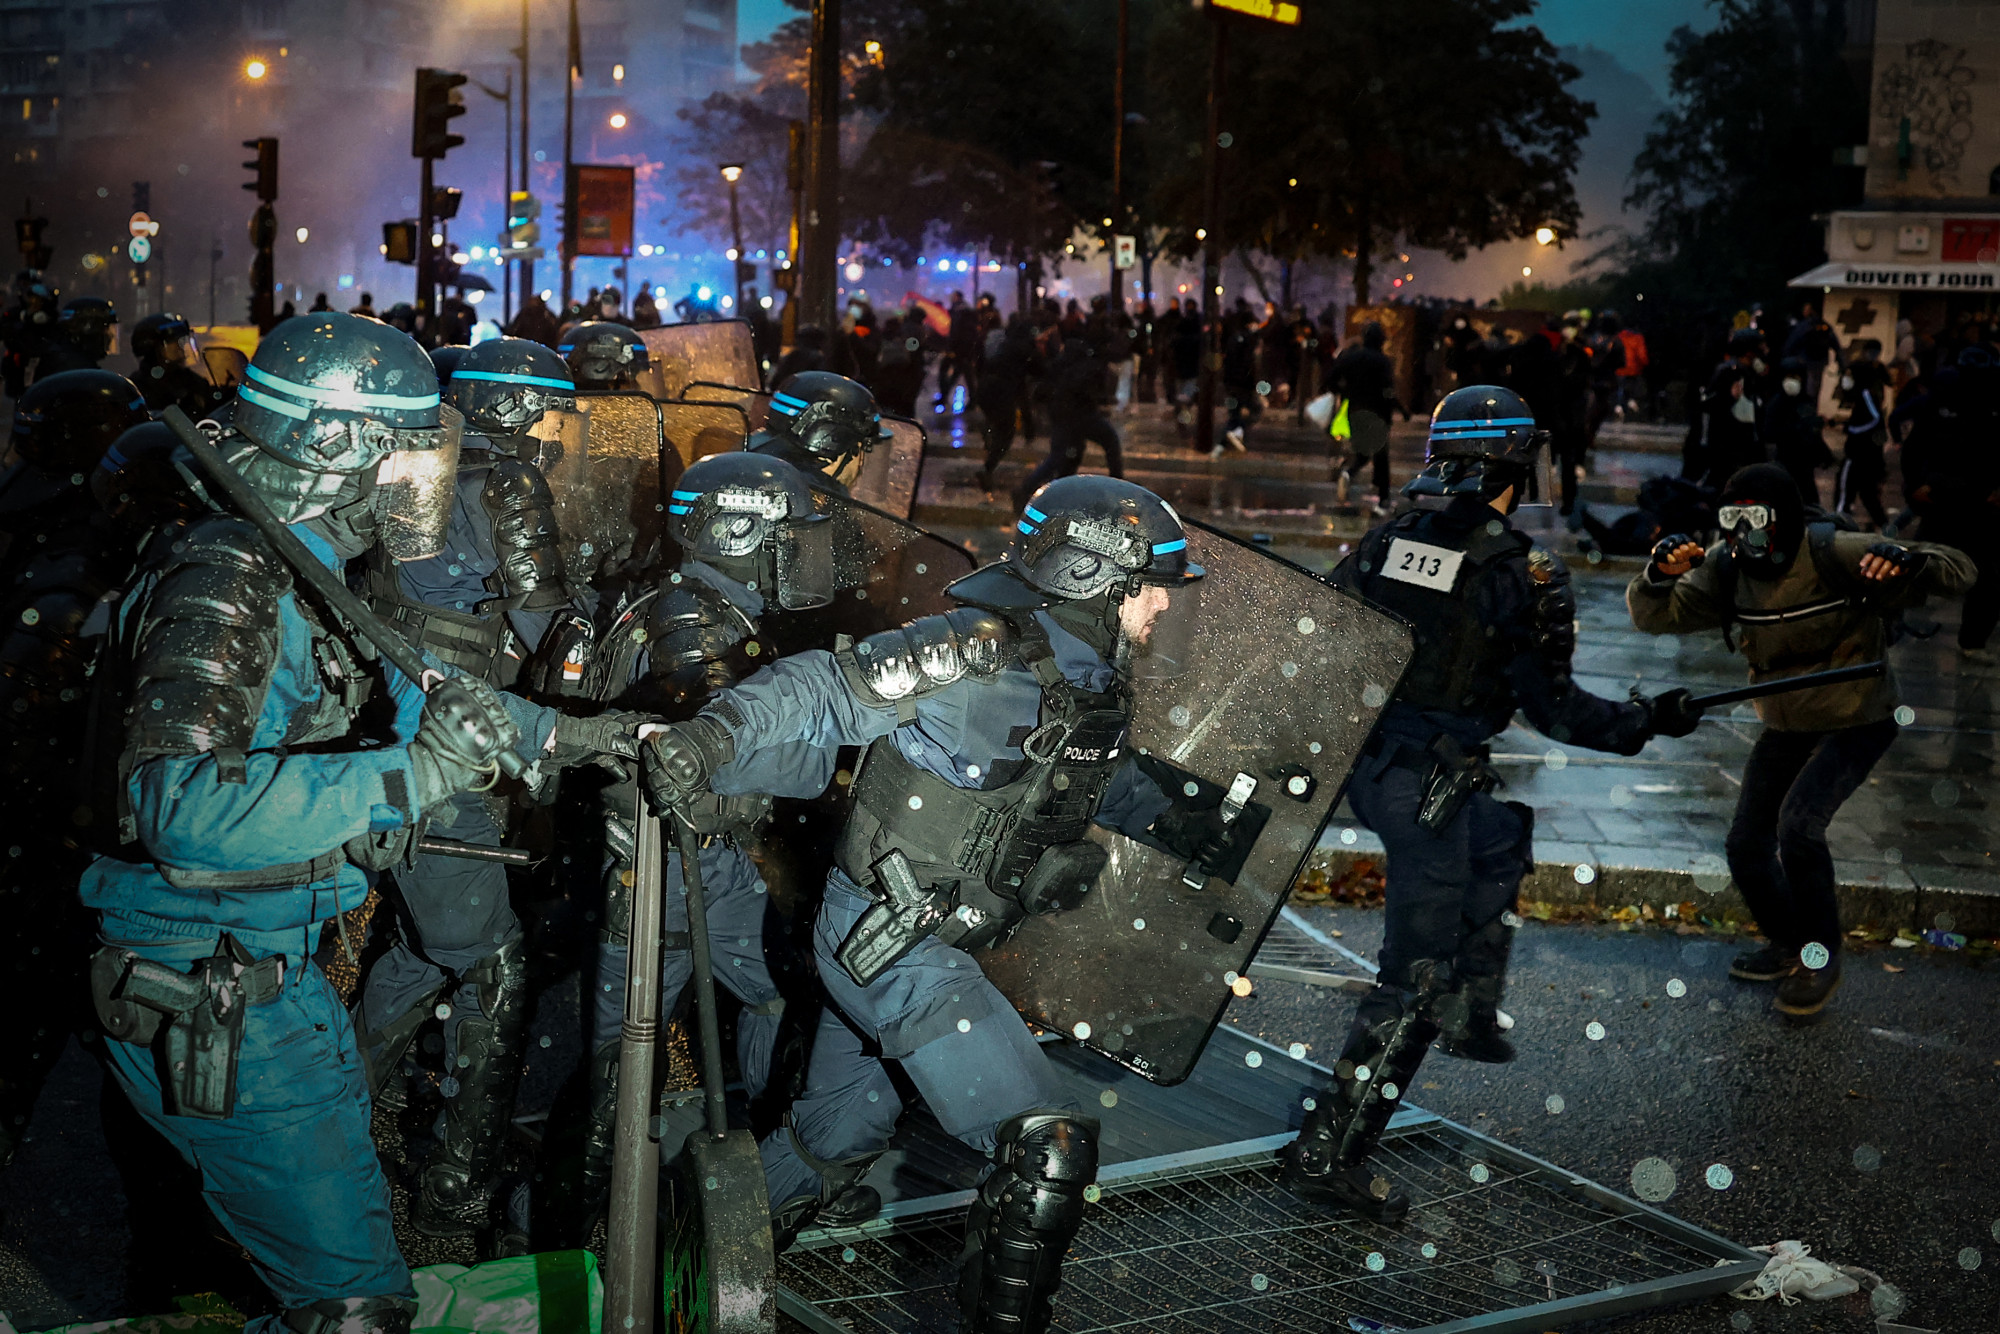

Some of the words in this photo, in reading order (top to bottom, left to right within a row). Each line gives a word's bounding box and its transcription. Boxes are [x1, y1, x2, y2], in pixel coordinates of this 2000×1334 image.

[1845, 269, 1931, 286] OUVERT
[1938, 271, 1994, 287] JOUR
[1400, 551, 1442, 577] 213
[1063, 746, 1101, 761] POLICE
